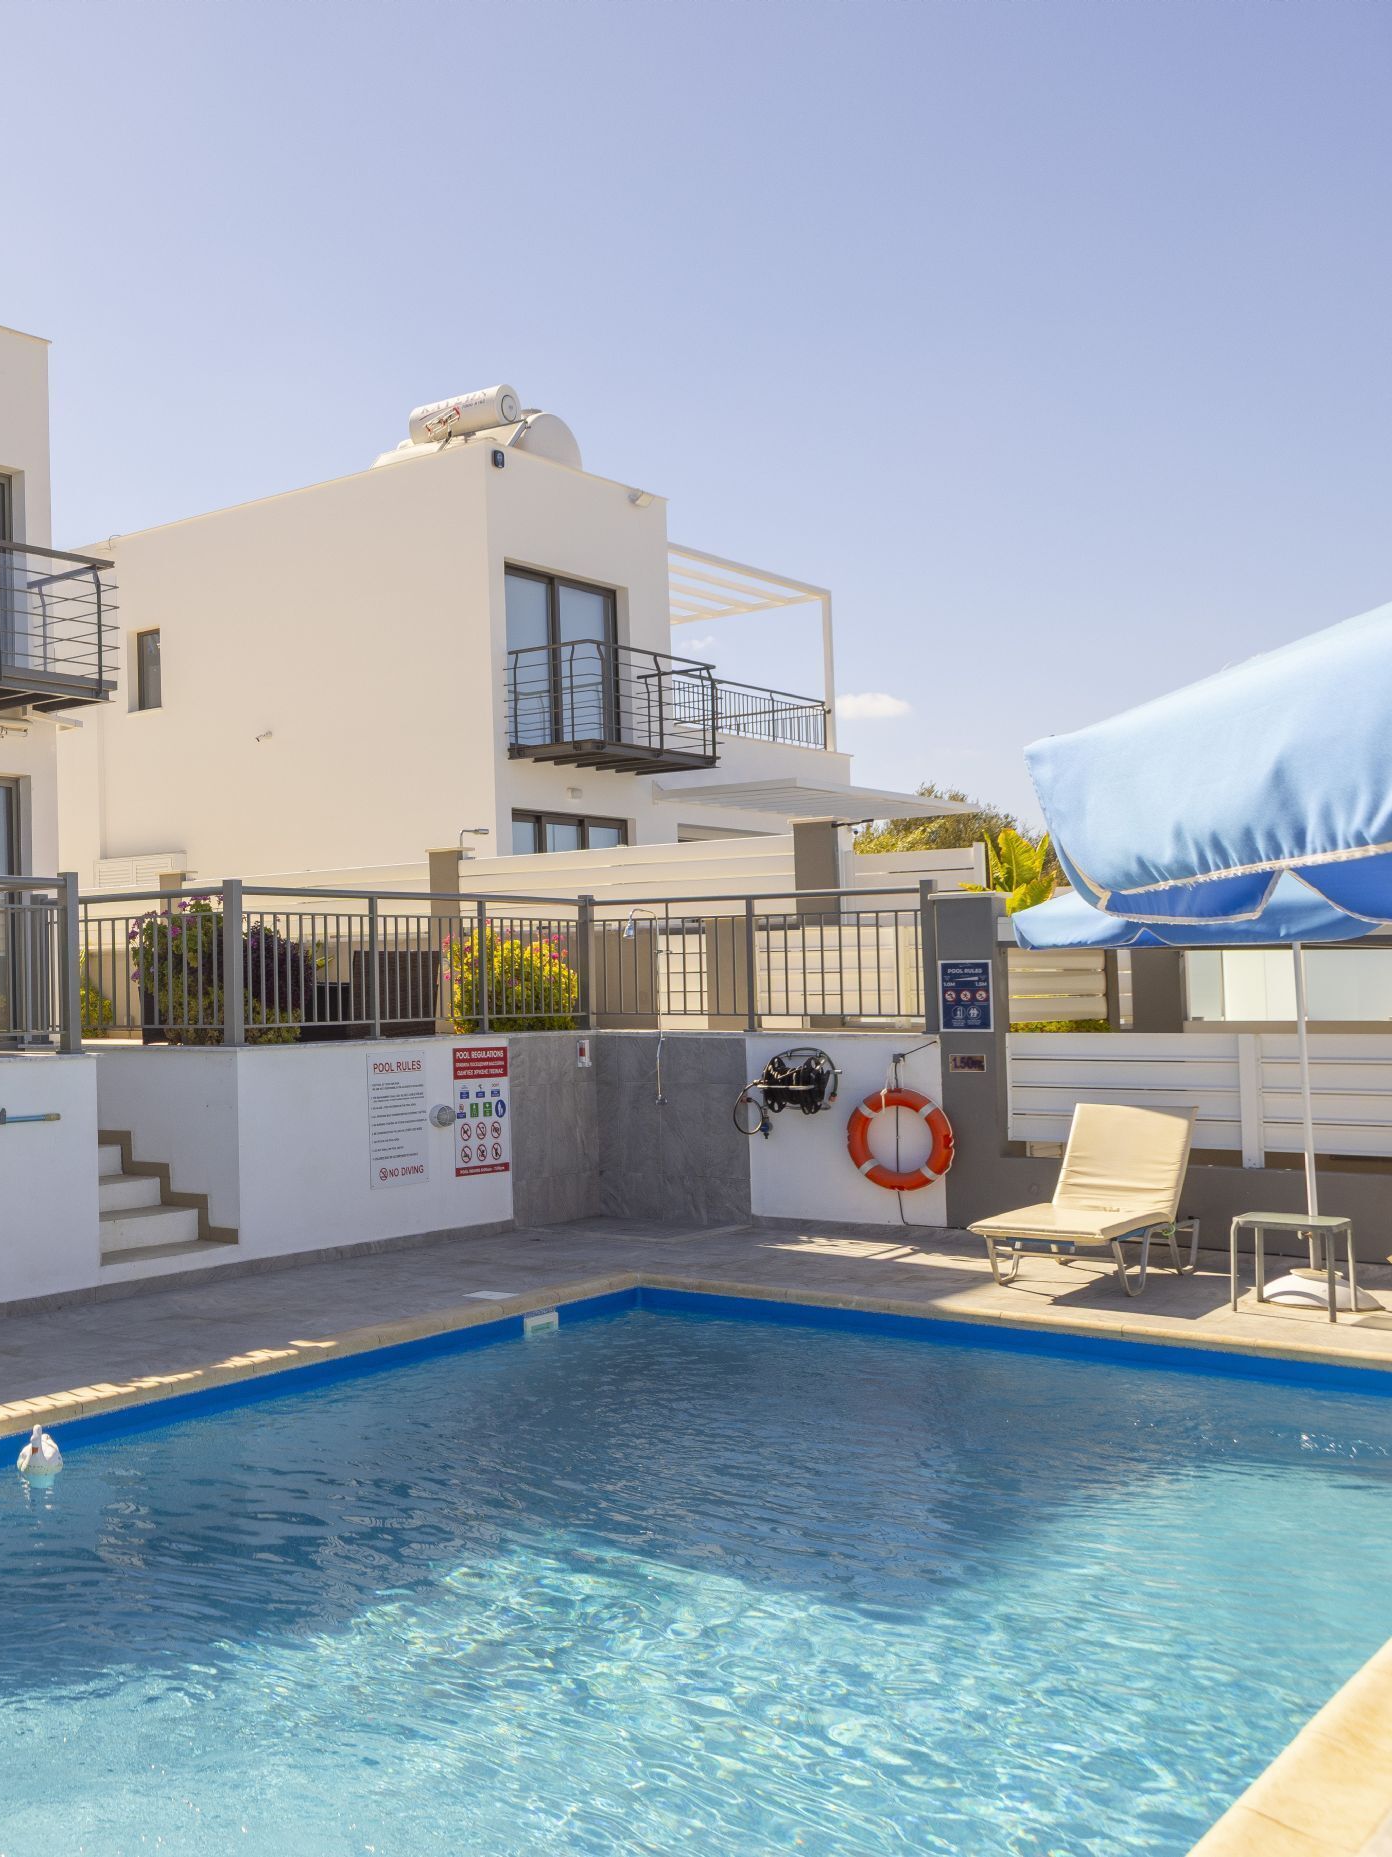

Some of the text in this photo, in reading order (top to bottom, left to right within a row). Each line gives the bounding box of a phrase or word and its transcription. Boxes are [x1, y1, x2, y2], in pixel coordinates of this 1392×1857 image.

[456, 1050, 504, 1060] POOL REGULATIONS
[373, 1060, 422, 1073] POOL RULES
[389, 1164, 424, 1178] NO DIVING
